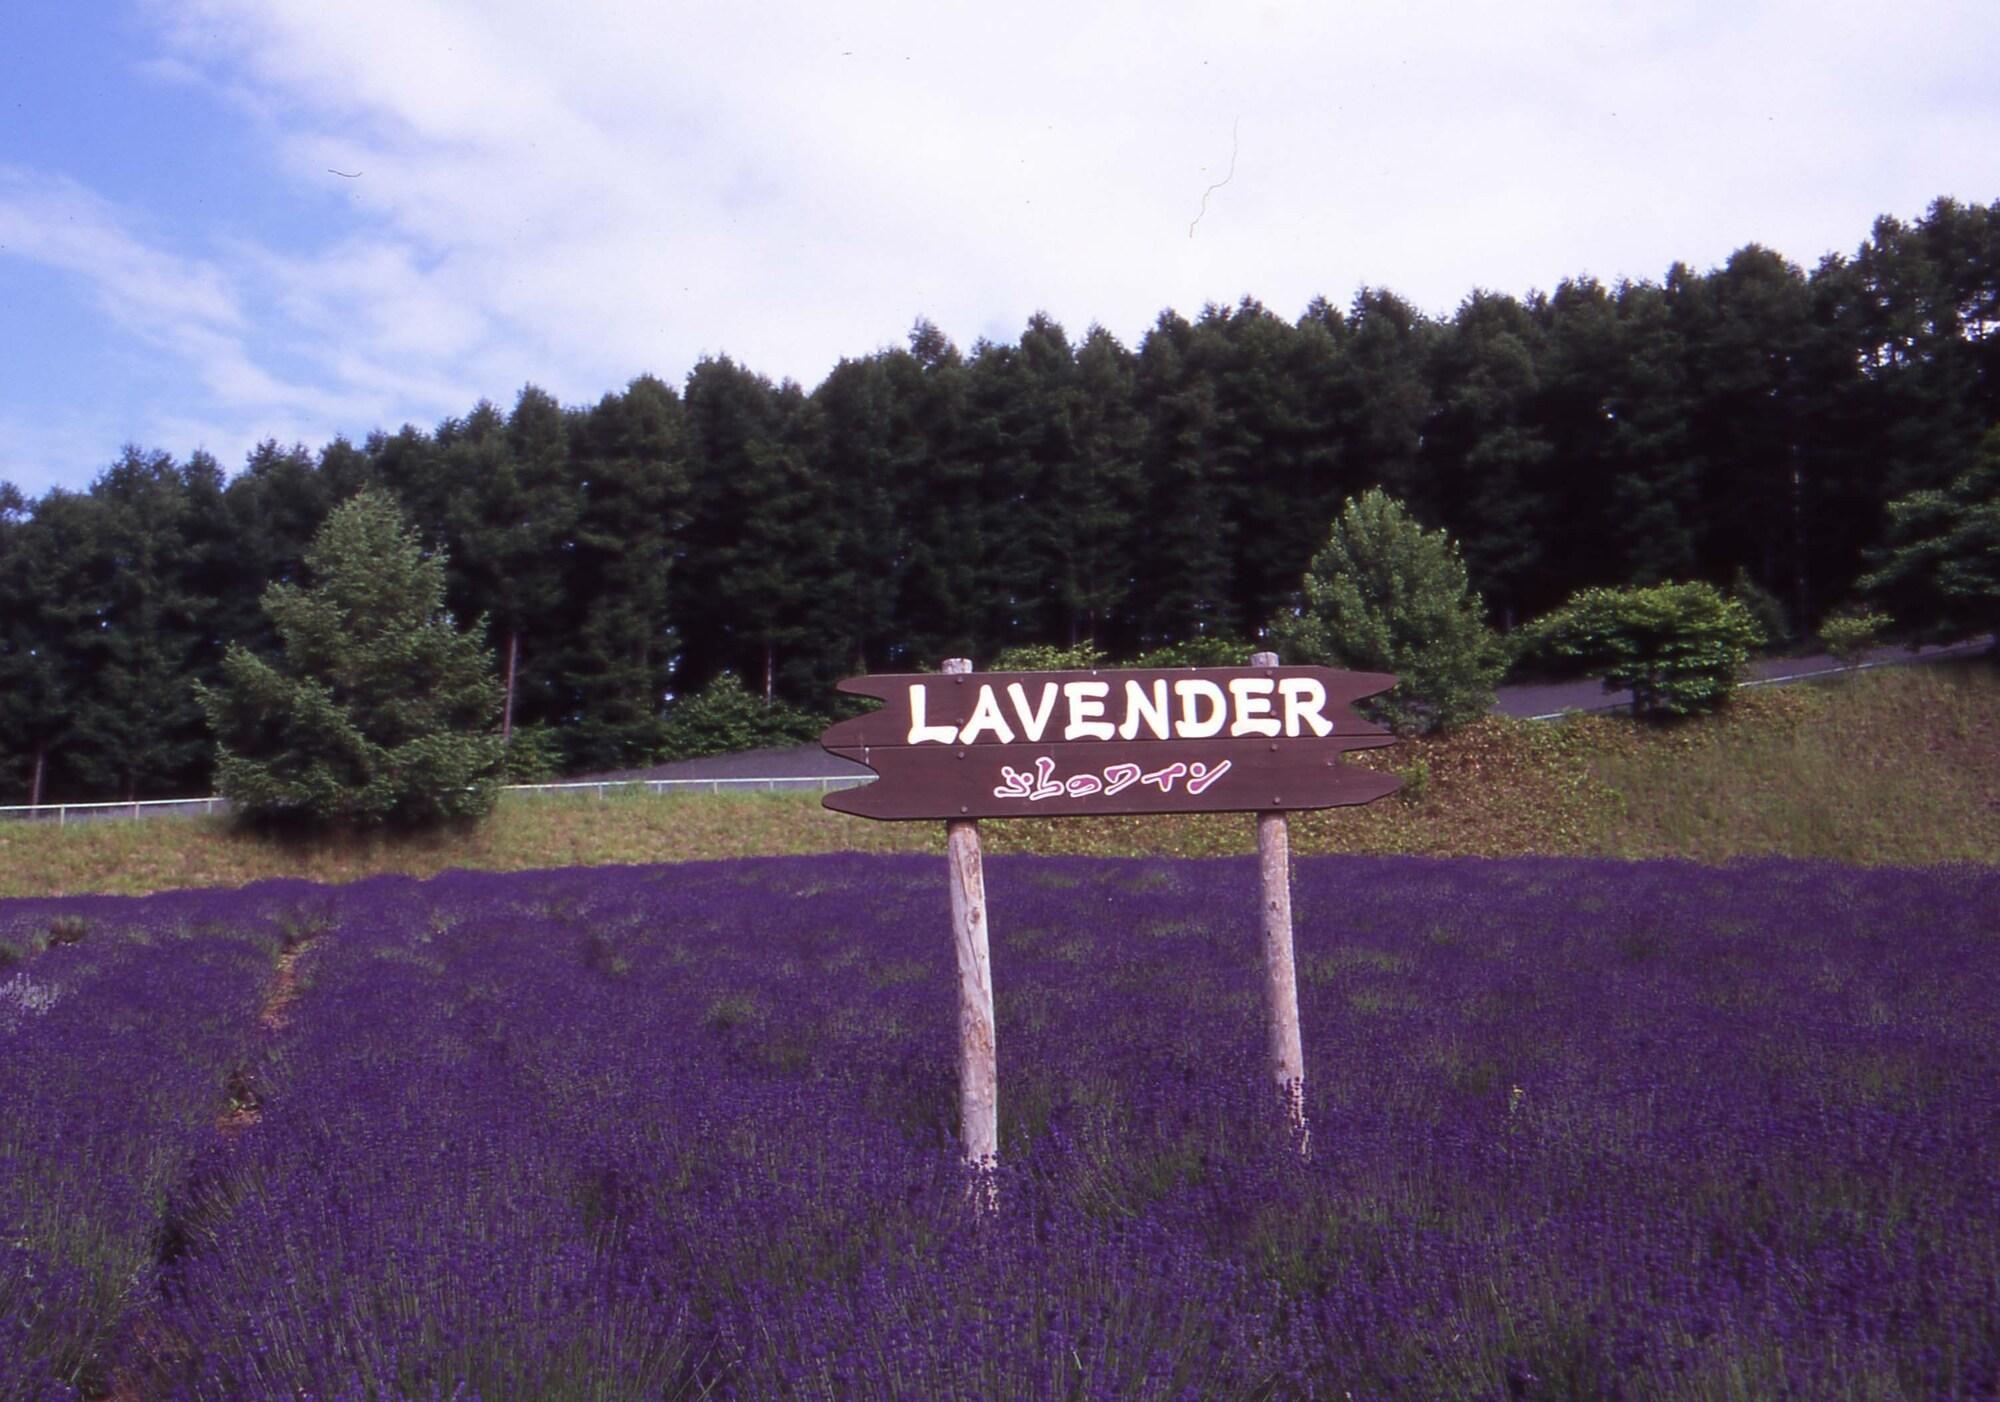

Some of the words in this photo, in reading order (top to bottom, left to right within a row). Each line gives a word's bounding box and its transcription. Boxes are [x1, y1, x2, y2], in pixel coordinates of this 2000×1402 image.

[907, 677, 1334, 746] LAVENDER
[992, 757, 1233, 802] ふらのワイン
